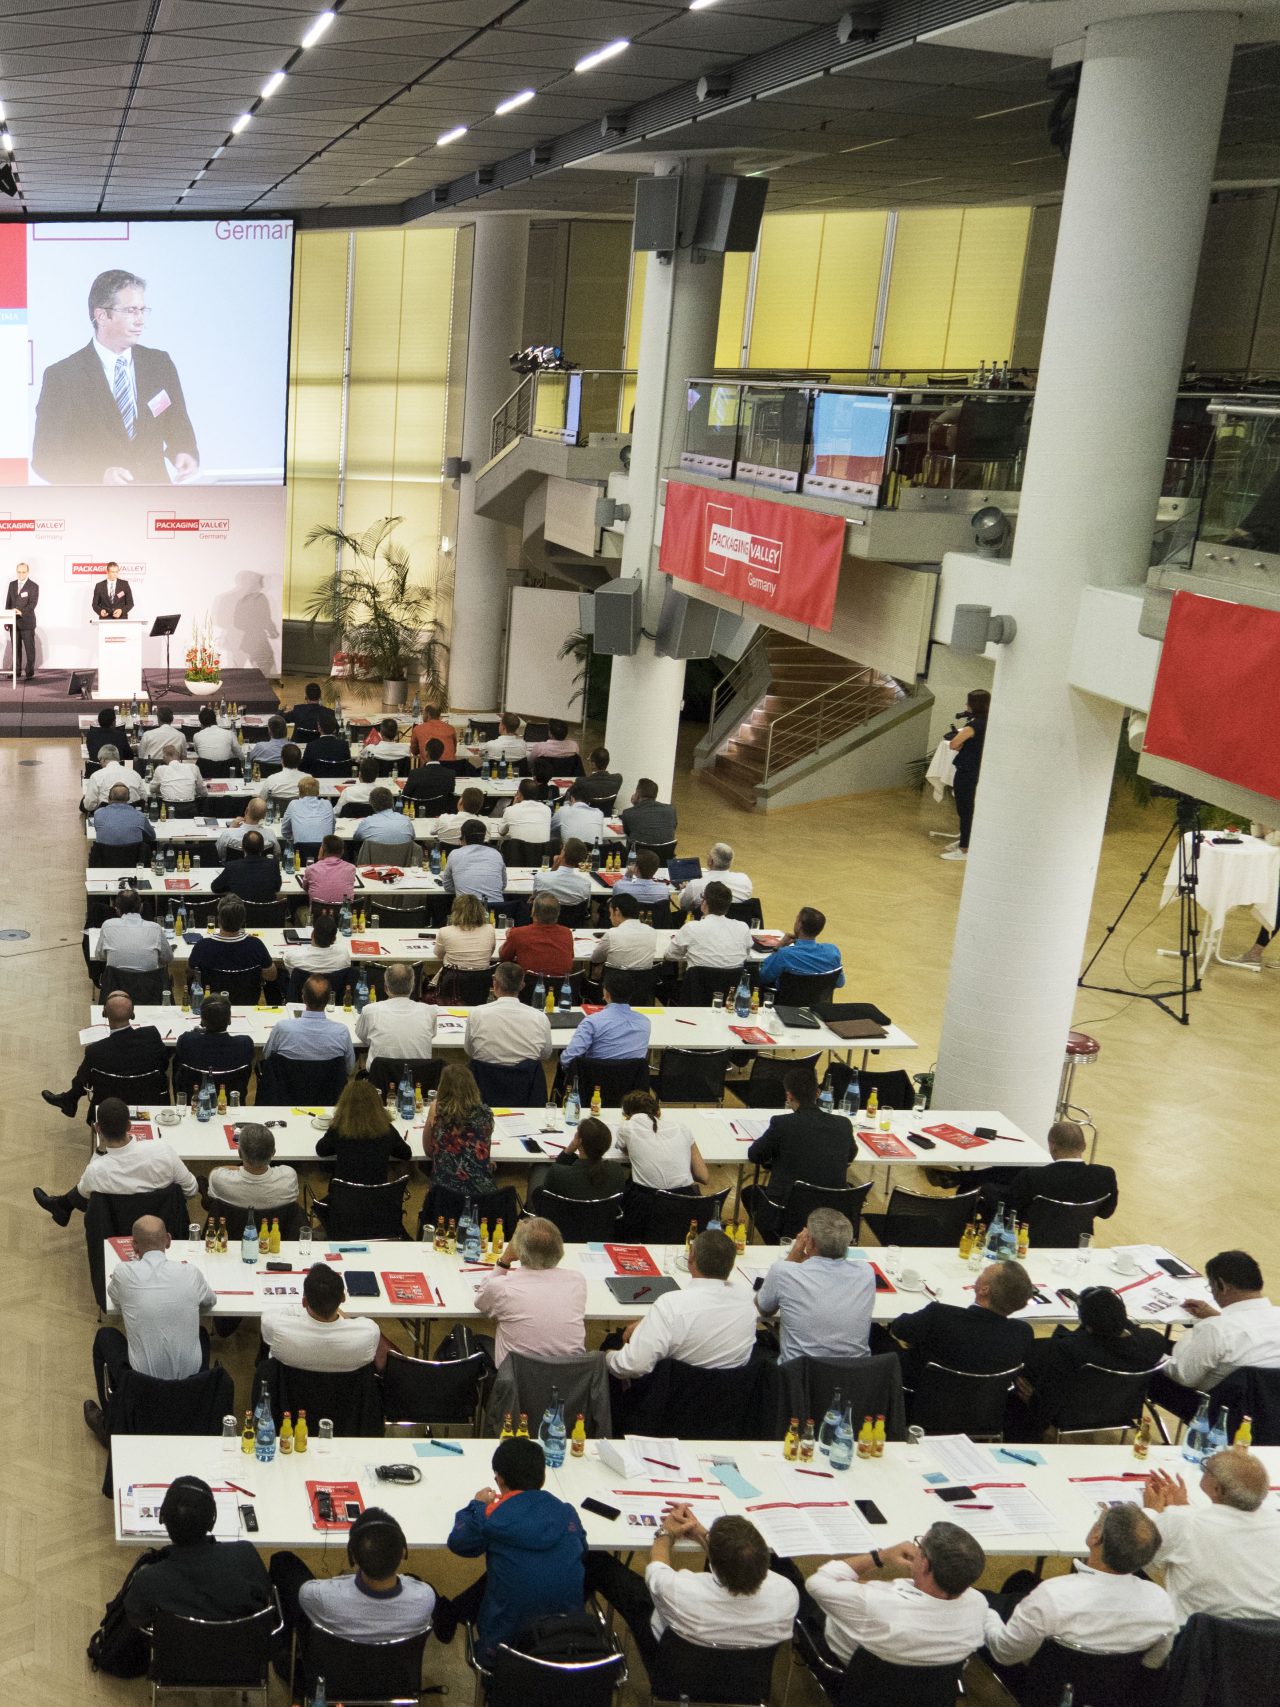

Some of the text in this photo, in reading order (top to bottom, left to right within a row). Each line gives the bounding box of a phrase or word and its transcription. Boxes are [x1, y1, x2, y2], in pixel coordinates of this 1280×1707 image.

[156, 521, 227, 529] PACKAGING VALLEY
[711, 532, 780, 565] PACKAGING VALLEY
[748, 571, 777, 597] Germany
